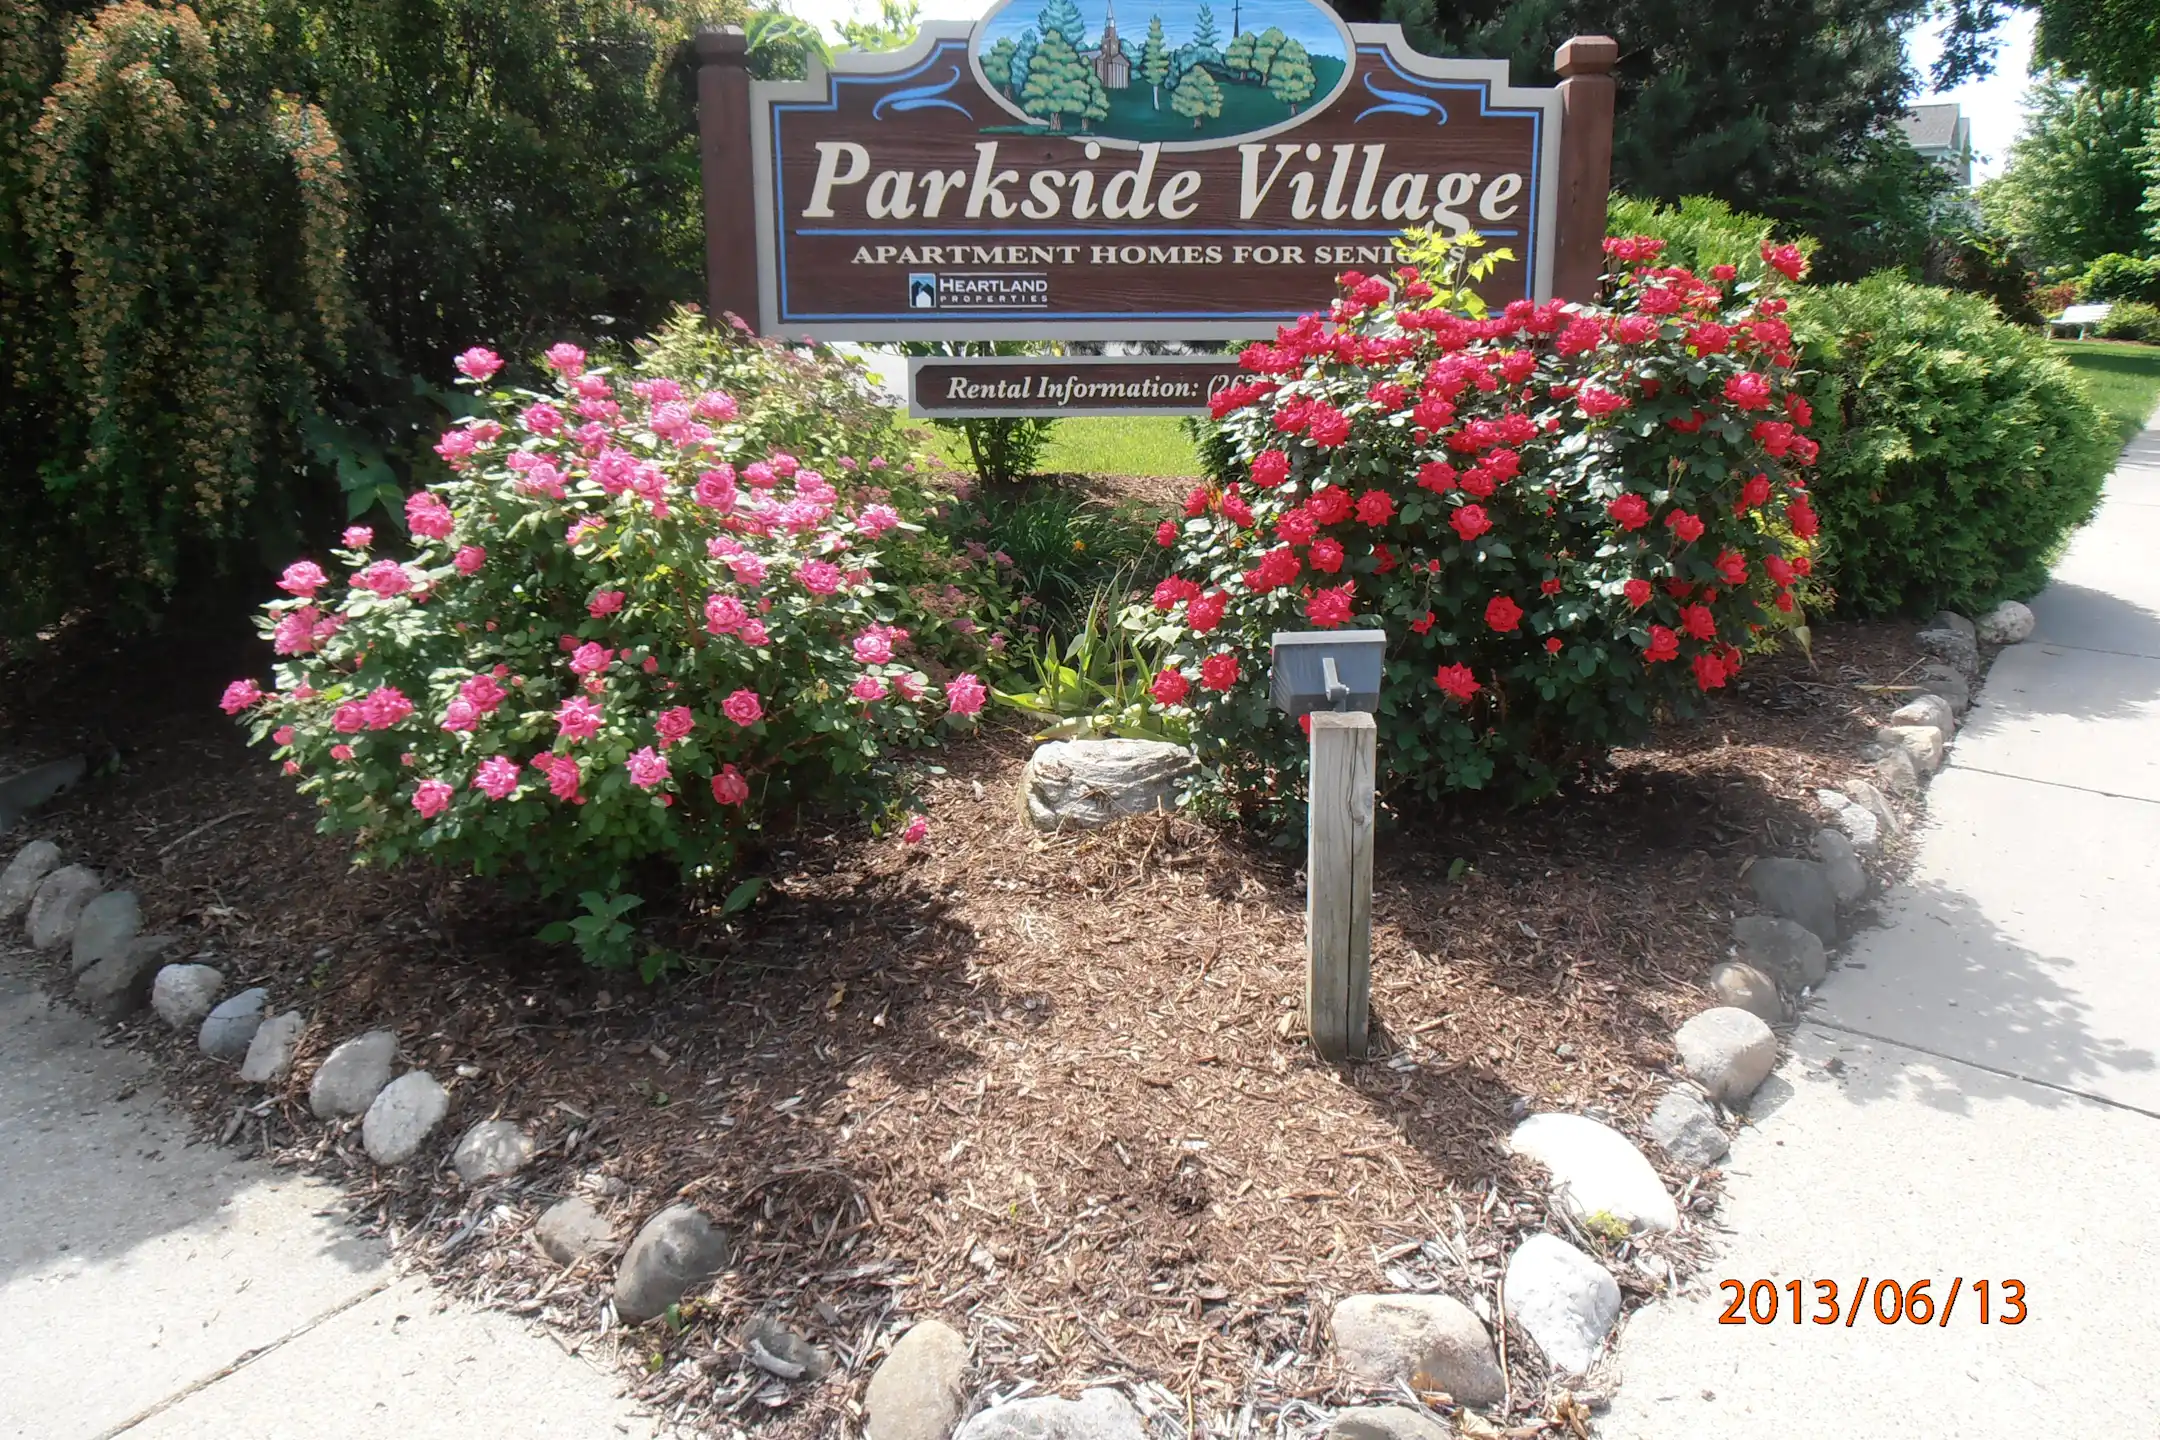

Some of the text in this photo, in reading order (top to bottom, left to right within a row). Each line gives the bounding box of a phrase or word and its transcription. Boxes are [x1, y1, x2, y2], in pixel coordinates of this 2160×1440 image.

[801, 140, 1523, 243] Parkside Village
[850, 245, 1466, 265] APARTMENT HOMES FOR SENIOS
[939, 294, 1049, 303] PROPERTIES
[946, 376, 1031, 399] Rental
[1037, 374, 1199, 406] Information:
